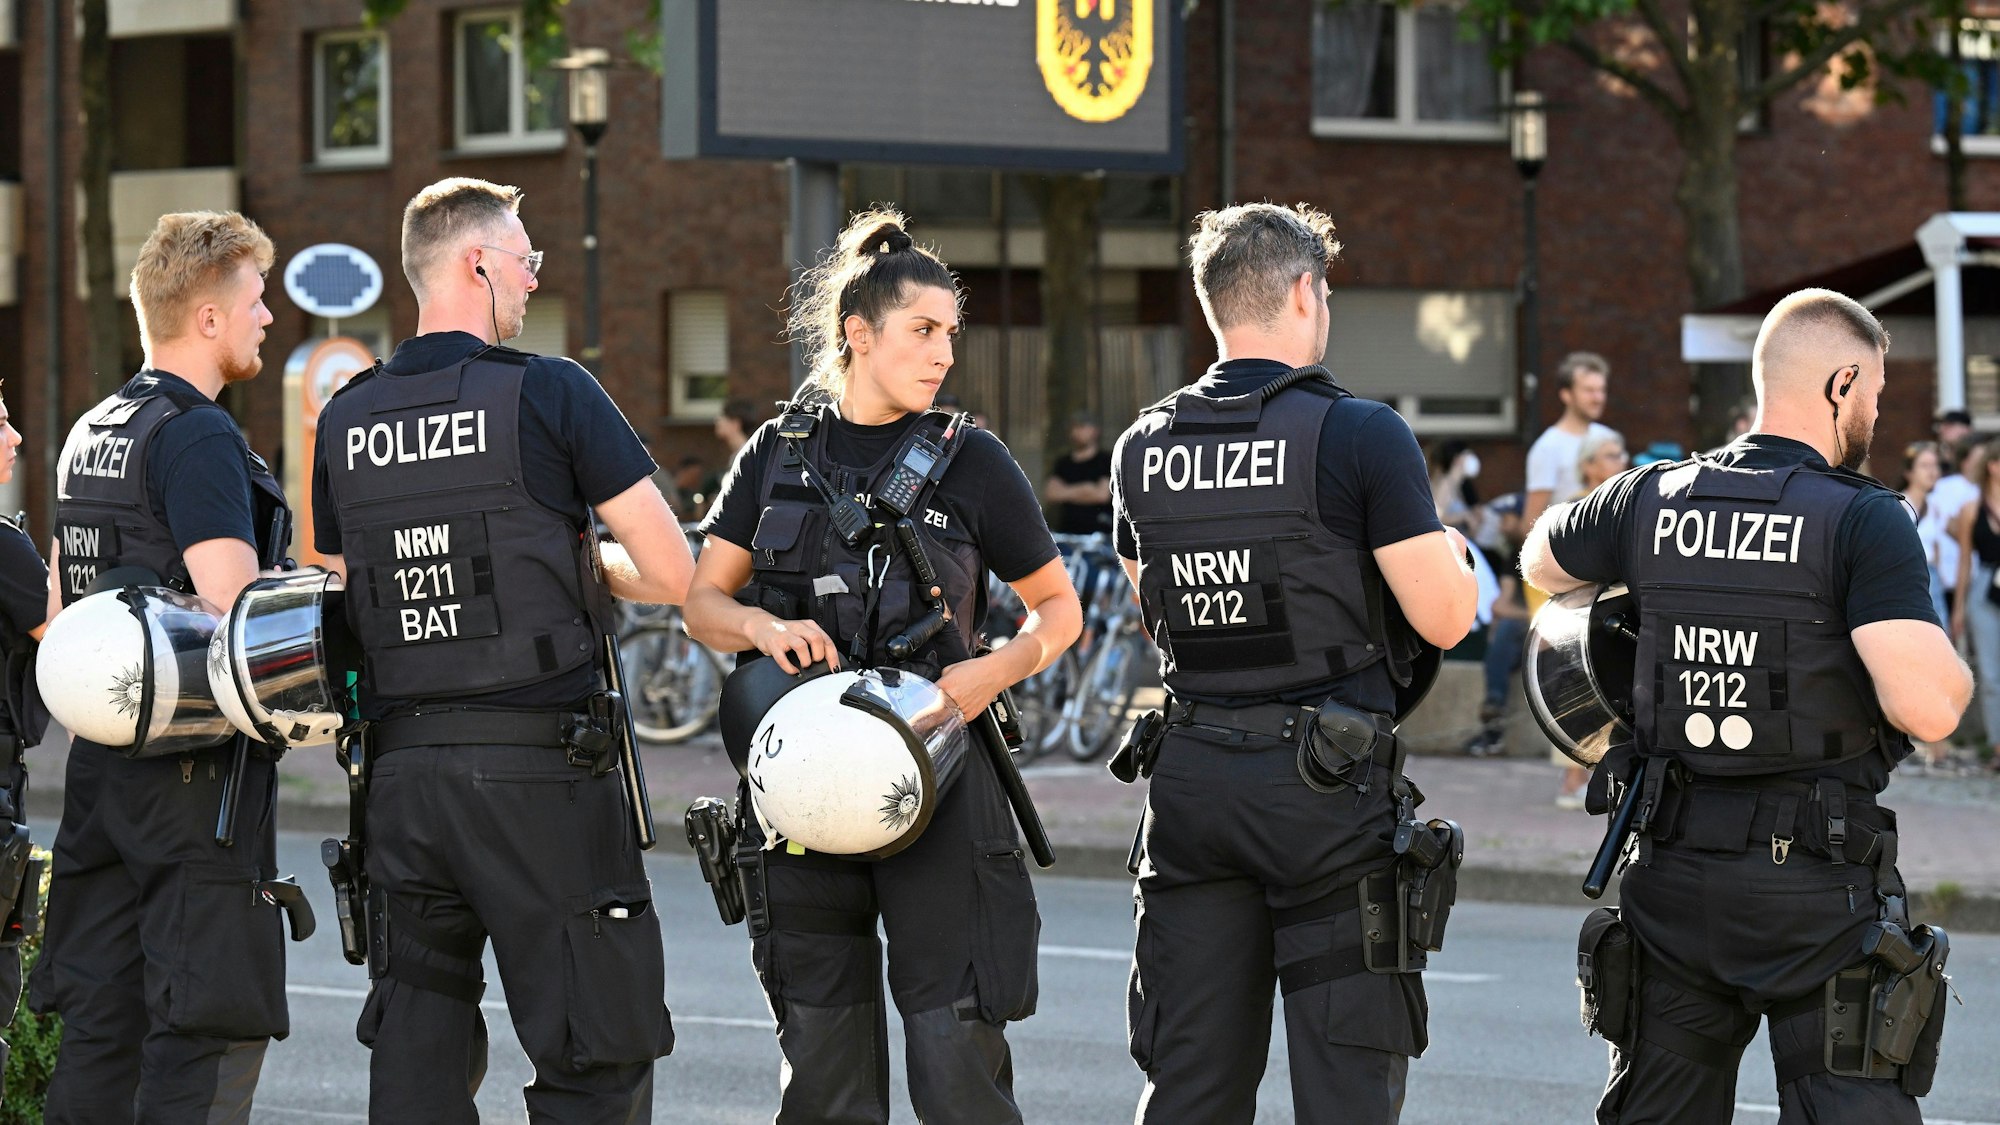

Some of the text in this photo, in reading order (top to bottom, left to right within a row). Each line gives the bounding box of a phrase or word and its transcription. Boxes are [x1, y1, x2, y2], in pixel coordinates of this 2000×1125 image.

[70, 436, 135, 479] OLIZEI
[347, 410, 486, 470] POLIZEI
[1143, 439, 1286, 492] POLIZEI
[63, 525, 100, 558] NRW
[394, 524, 449, 559] NRW
[1653, 508, 1805, 563] POLIZEI
[394, 563, 455, 600] 1211
[1171, 548, 1251, 586] NRW
[400, 603, 461, 641] BAT
[1181, 589, 1248, 626] 1212
[1673, 624, 1759, 666] NRW
[1679, 669, 1747, 708] 1212
